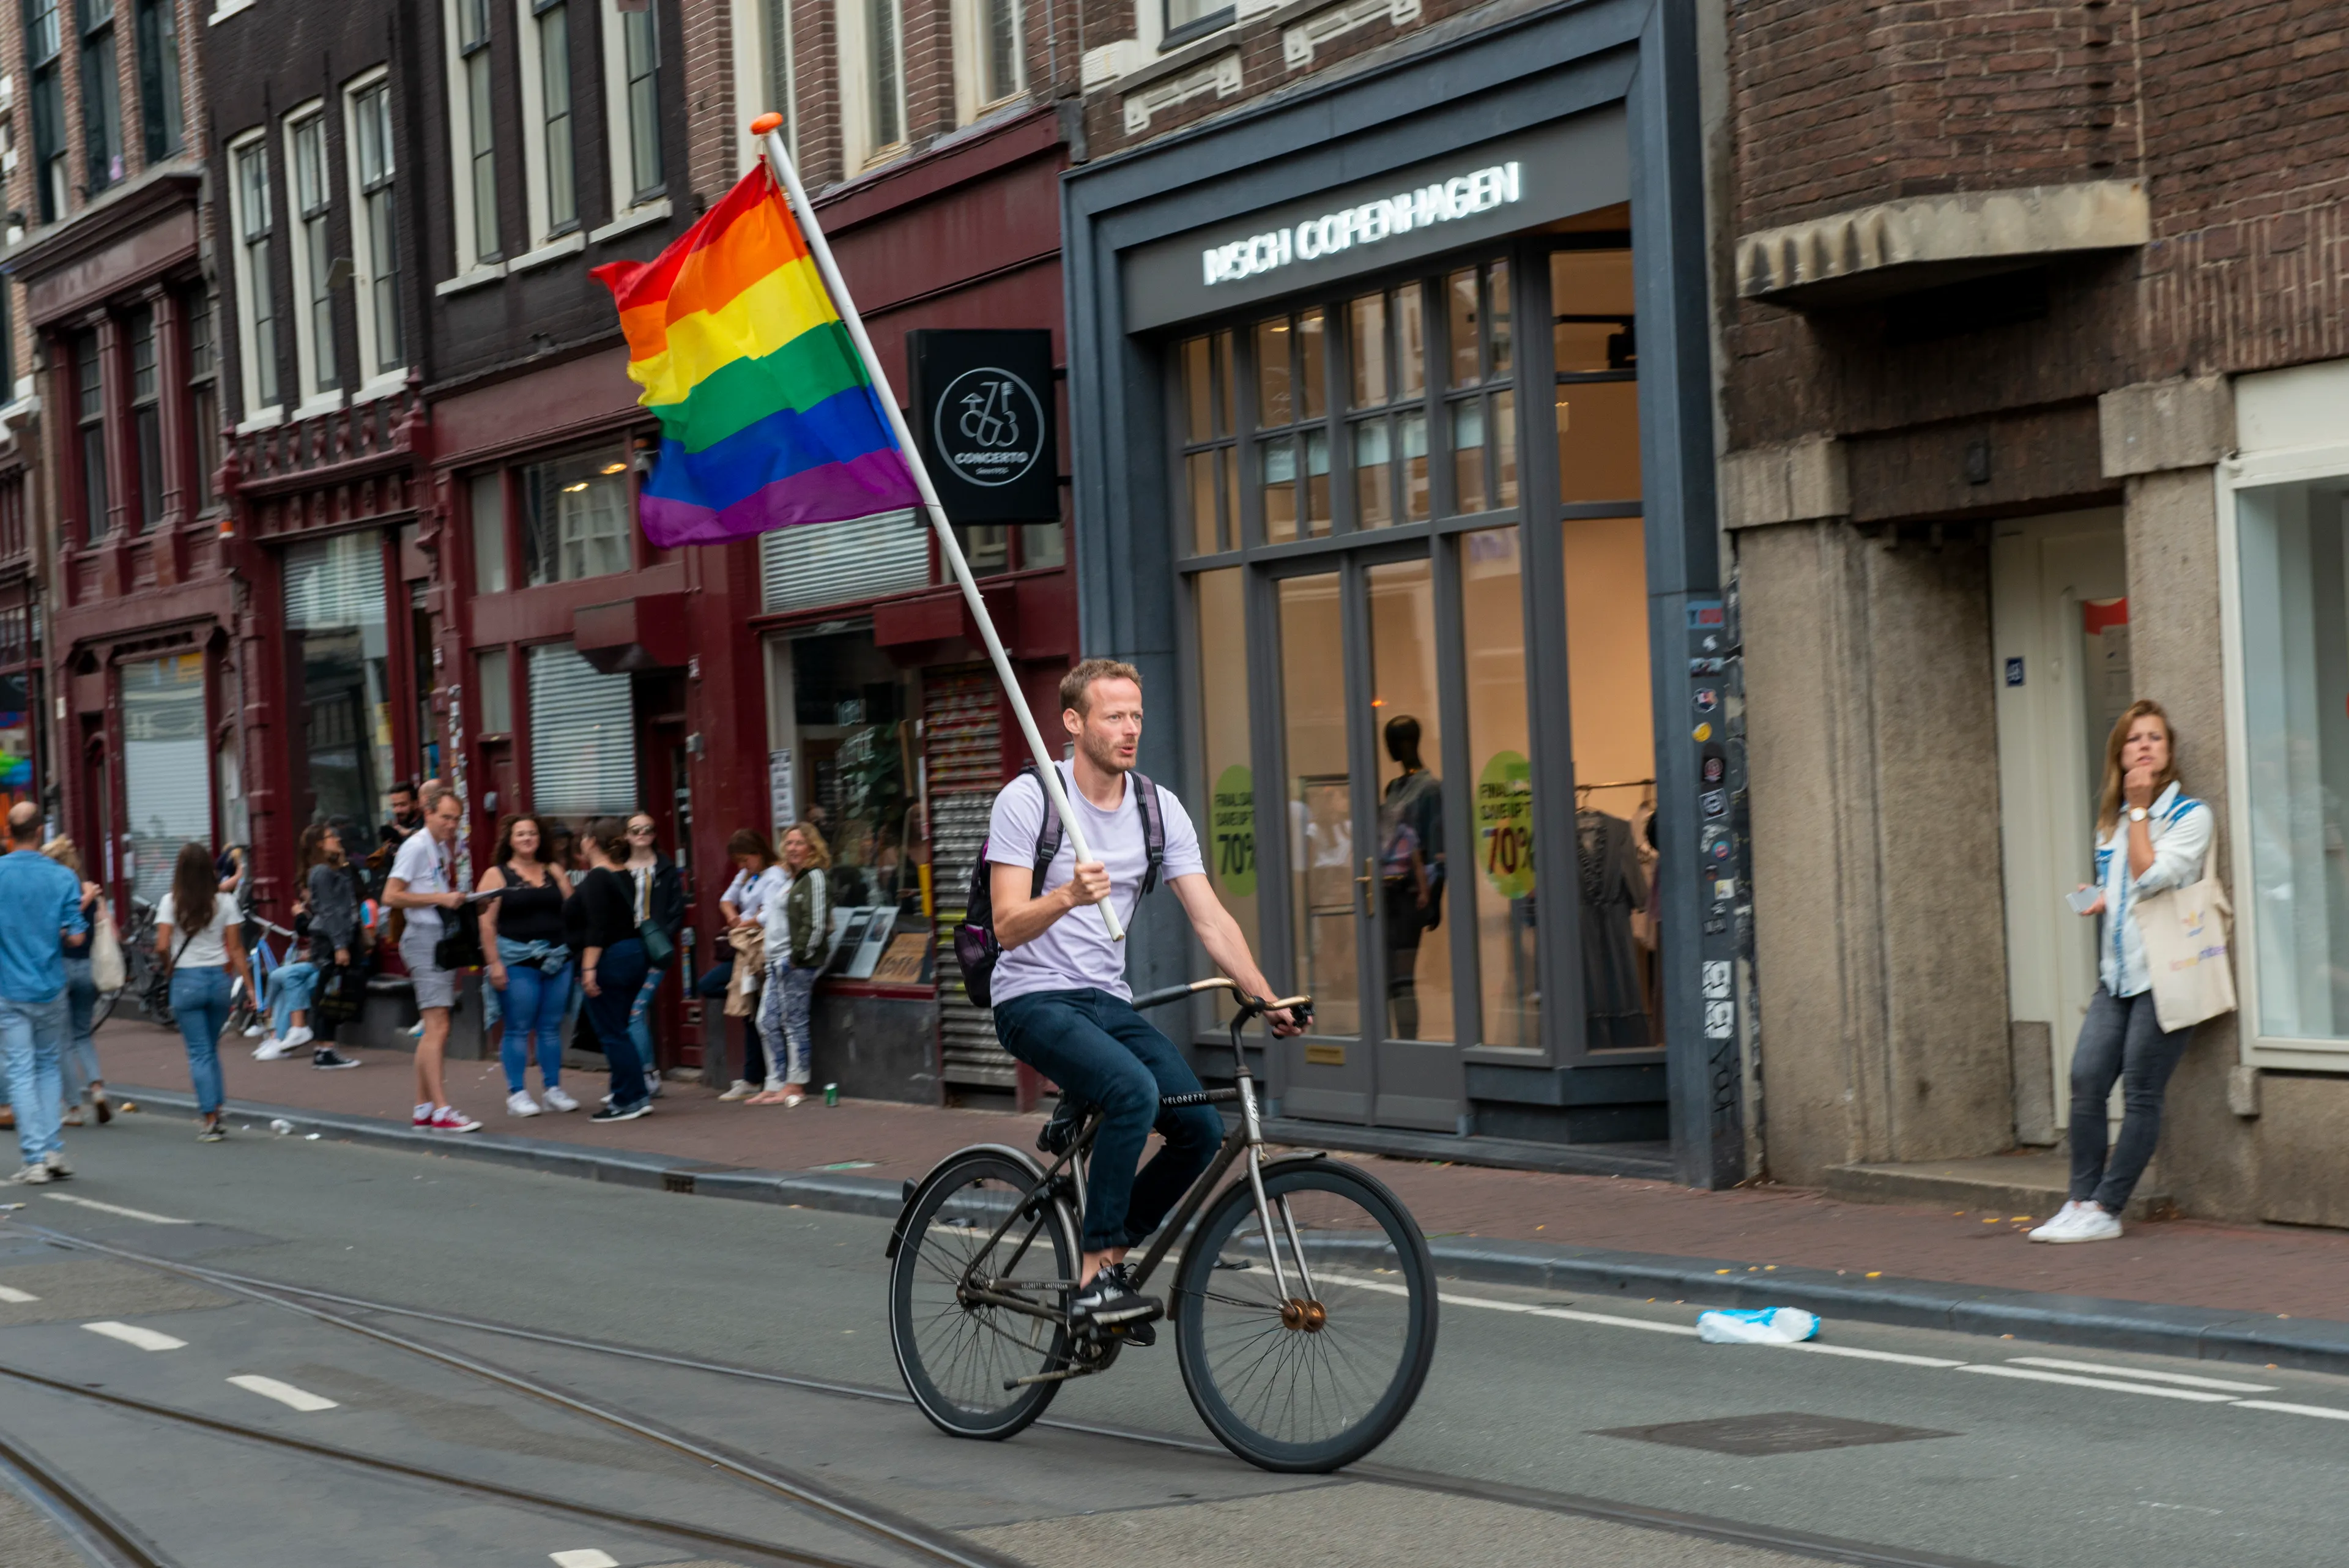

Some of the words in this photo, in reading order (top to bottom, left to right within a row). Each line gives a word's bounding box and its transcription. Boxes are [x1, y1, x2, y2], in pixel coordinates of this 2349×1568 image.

[1295, 160, 1522, 261] COPENHAGEN
[954, 451, 1029, 465] CONCERTO
[1482, 826, 1536, 874] 70%
[1162, 1093, 1208, 1105] VELORETTI
[1044, 1282, 1069, 1290] AMSTERDAM
